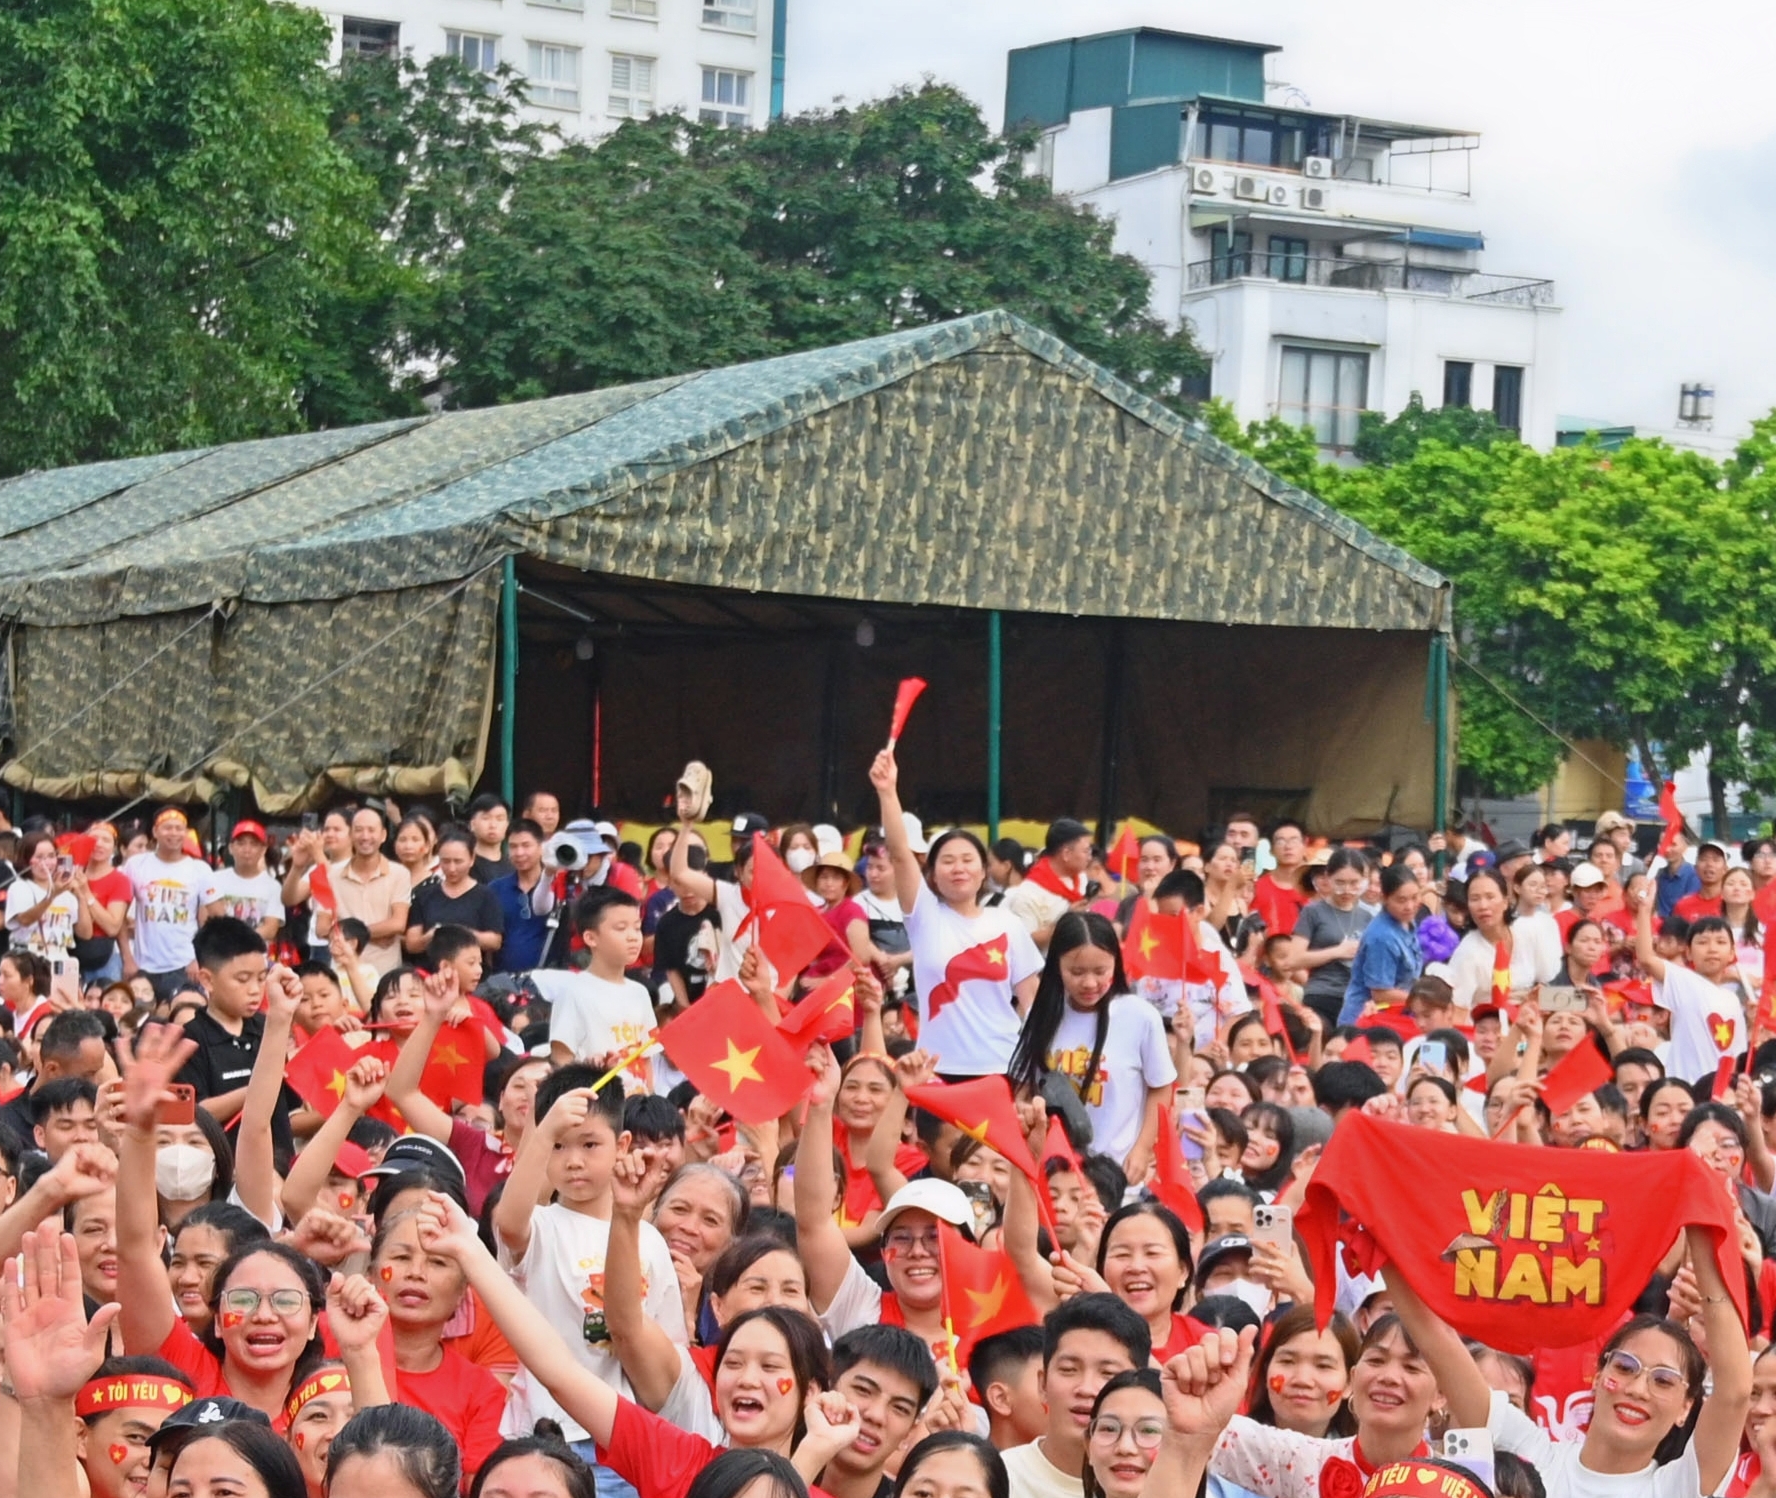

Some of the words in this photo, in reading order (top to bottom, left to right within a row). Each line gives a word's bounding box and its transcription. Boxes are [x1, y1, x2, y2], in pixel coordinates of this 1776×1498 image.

[1460, 1183, 1605, 1251] VIỆT
[1454, 1246, 1603, 1305] NAM
[108, 1381, 129, 1401] TÔI
[131, 1380, 158, 1400] YÊU
[1379, 1463, 1411, 1487] YÊU
